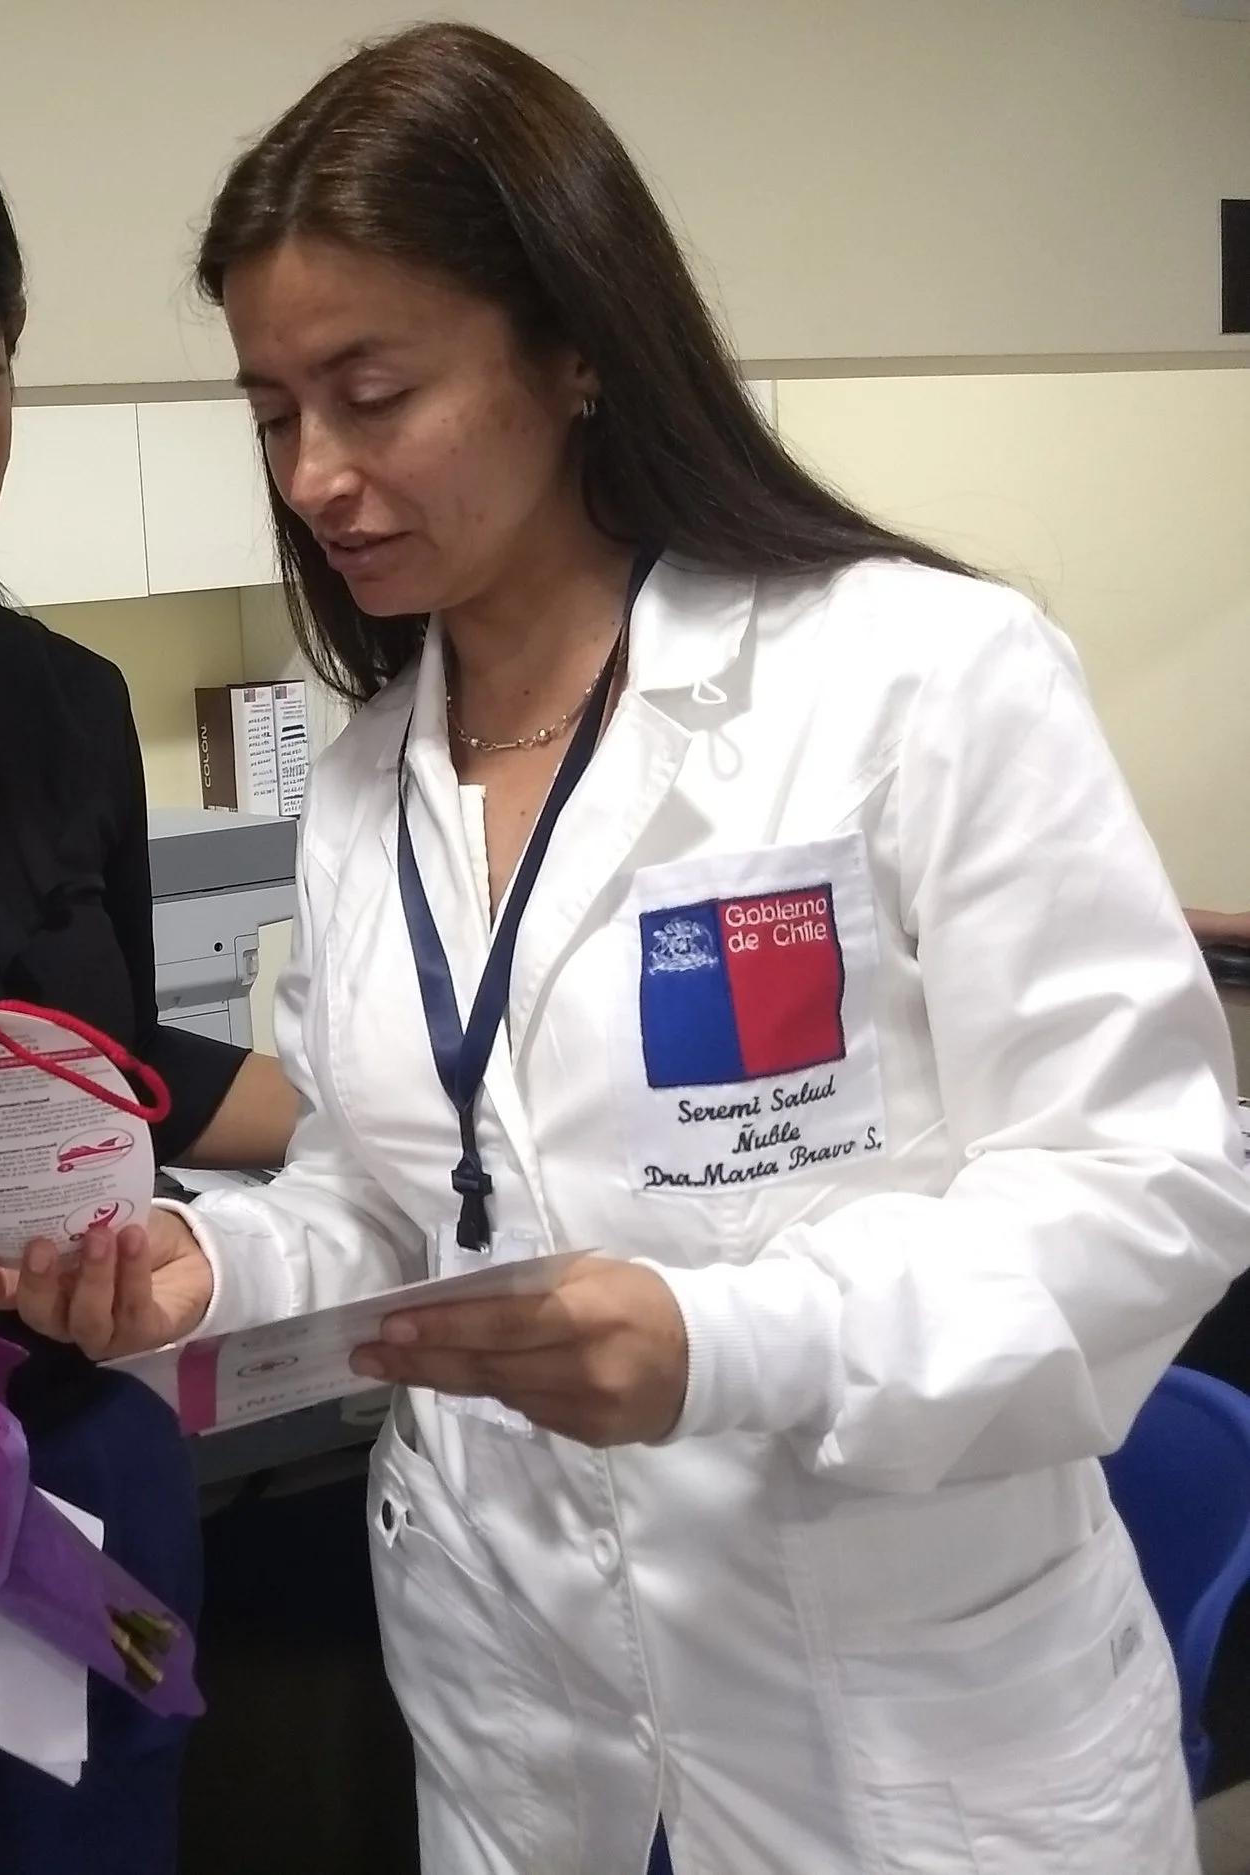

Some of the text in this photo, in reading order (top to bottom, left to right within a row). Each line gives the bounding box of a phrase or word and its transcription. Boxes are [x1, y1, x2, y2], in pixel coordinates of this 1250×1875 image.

[725, 898, 827, 927] Gobierno
[728, 920, 827, 953] de Chile
[678, 1074, 836, 1124] Seremi Salud
[732, 1121, 801, 1153] Ñuble
[788, 1140, 856, 1171] Bravo
